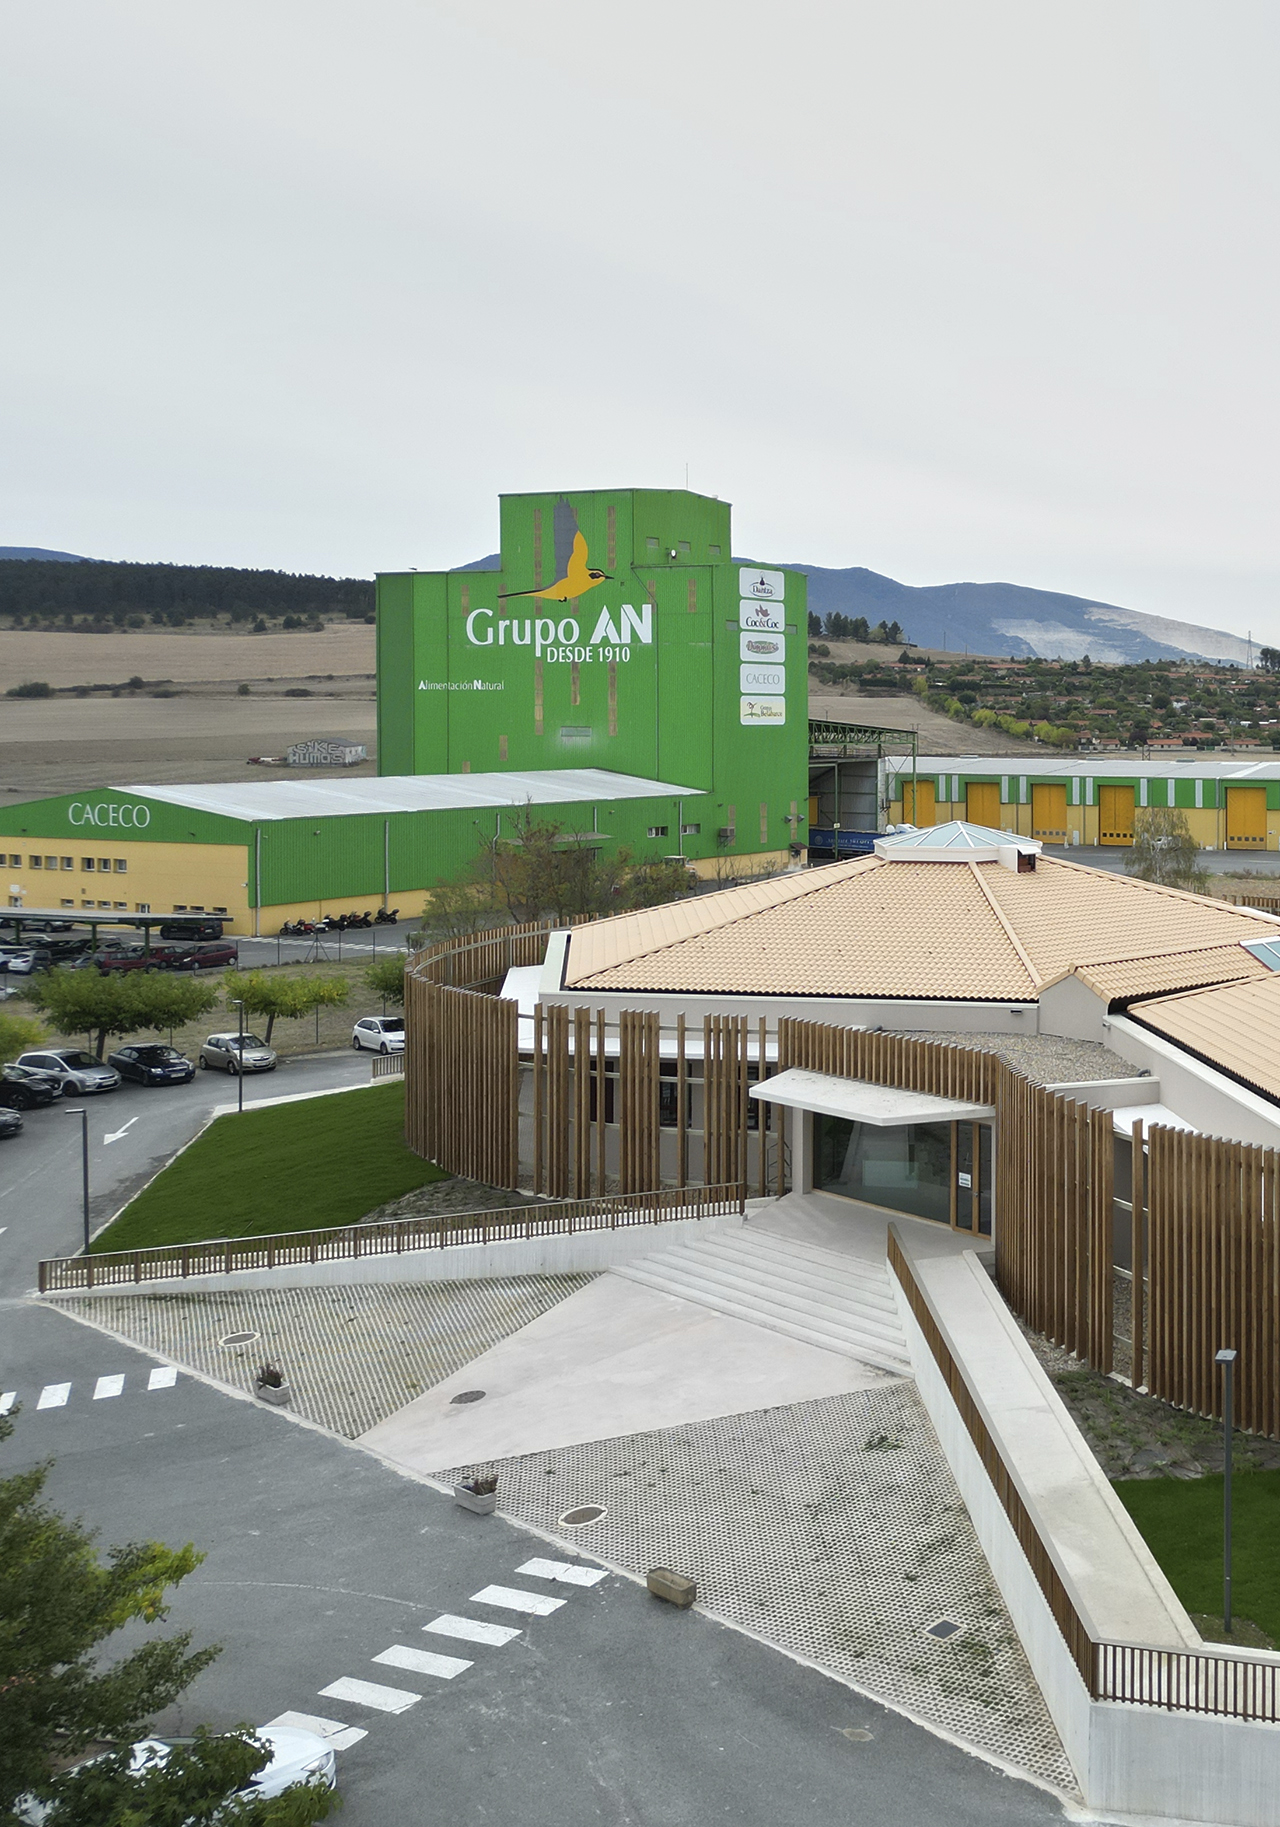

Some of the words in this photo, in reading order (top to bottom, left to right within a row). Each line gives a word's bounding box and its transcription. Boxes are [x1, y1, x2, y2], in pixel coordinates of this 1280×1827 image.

[466, 608, 580, 657] Grupo
[589, 604, 652, 644] AN
[547, 646, 593, 663] DESDE
[597, 646, 630, 662] 1910
[746, 673, 780, 685] CACECO
[68, 803, 150, 828] CACECO
